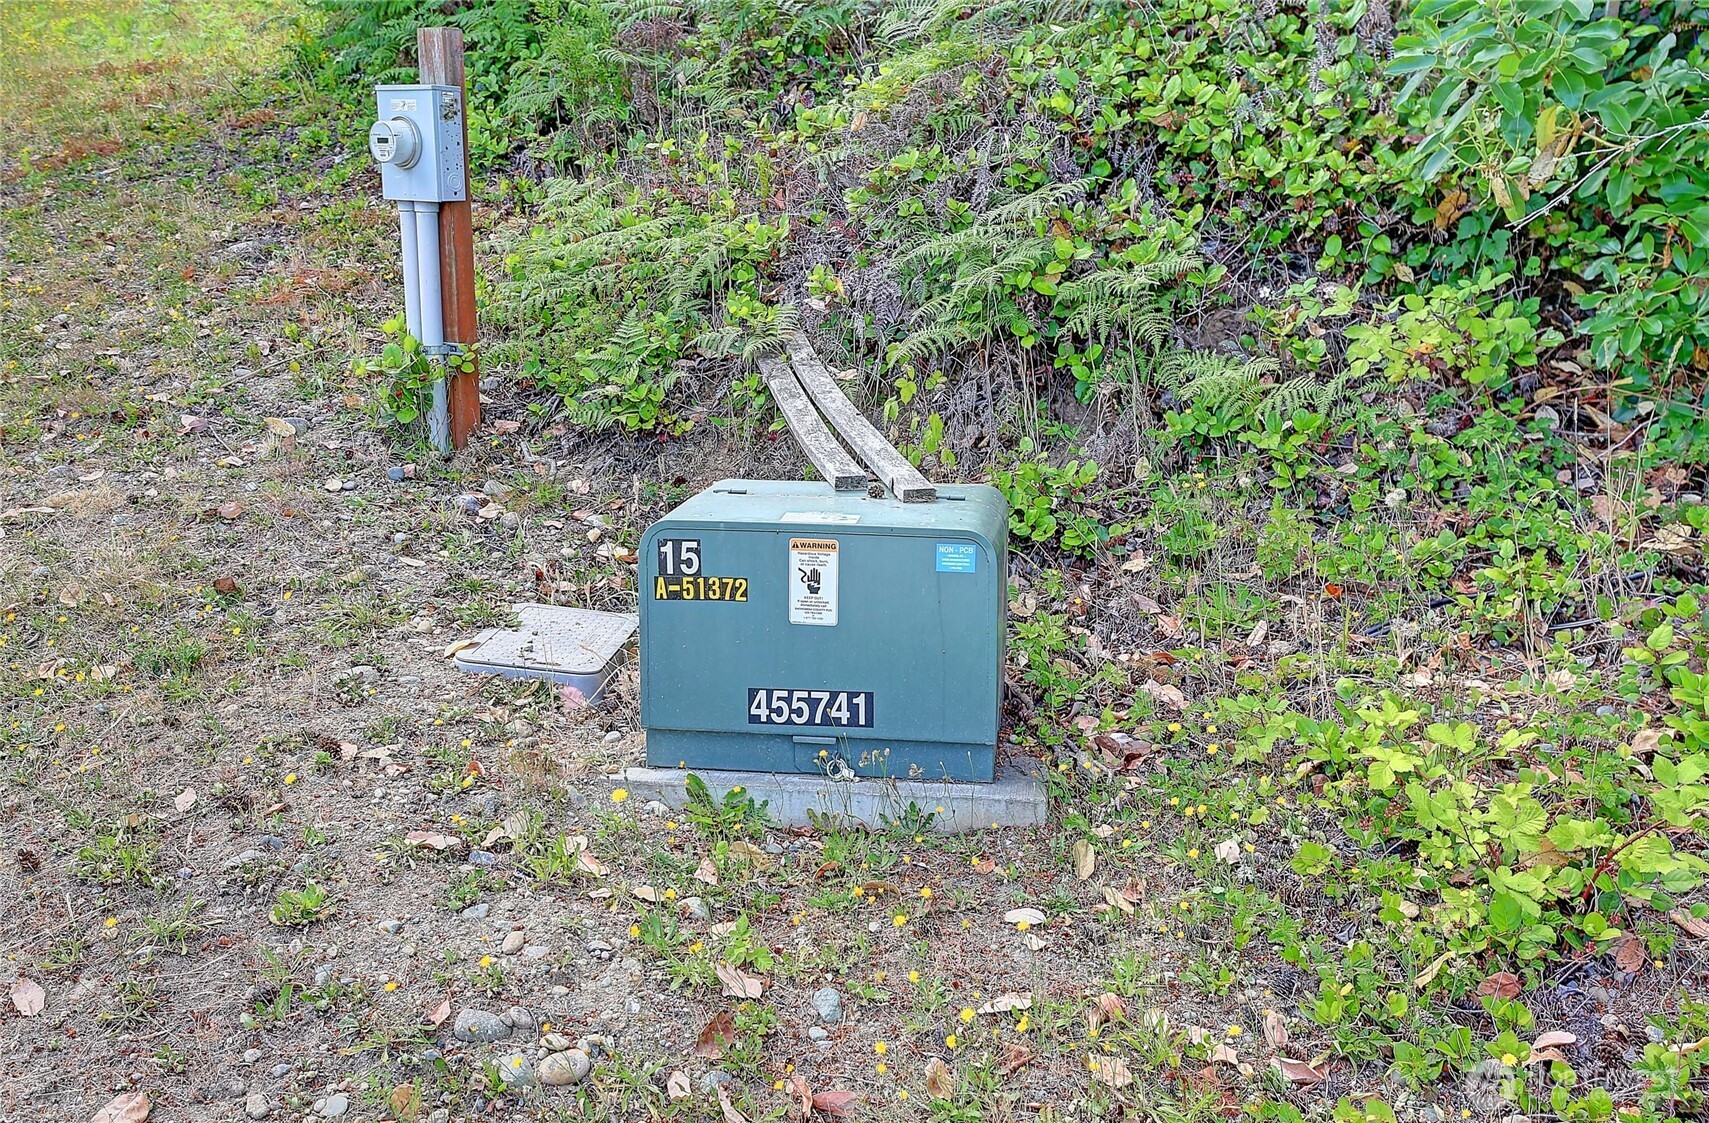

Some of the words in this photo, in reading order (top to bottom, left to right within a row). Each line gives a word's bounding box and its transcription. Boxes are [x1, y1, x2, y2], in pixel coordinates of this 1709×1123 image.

[660, 541, 700, 575] 15
[799, 542, 837, 550] WARNING
[655, 576, 747, 602] A-51372
[750, 689, 866, 726] 455741
